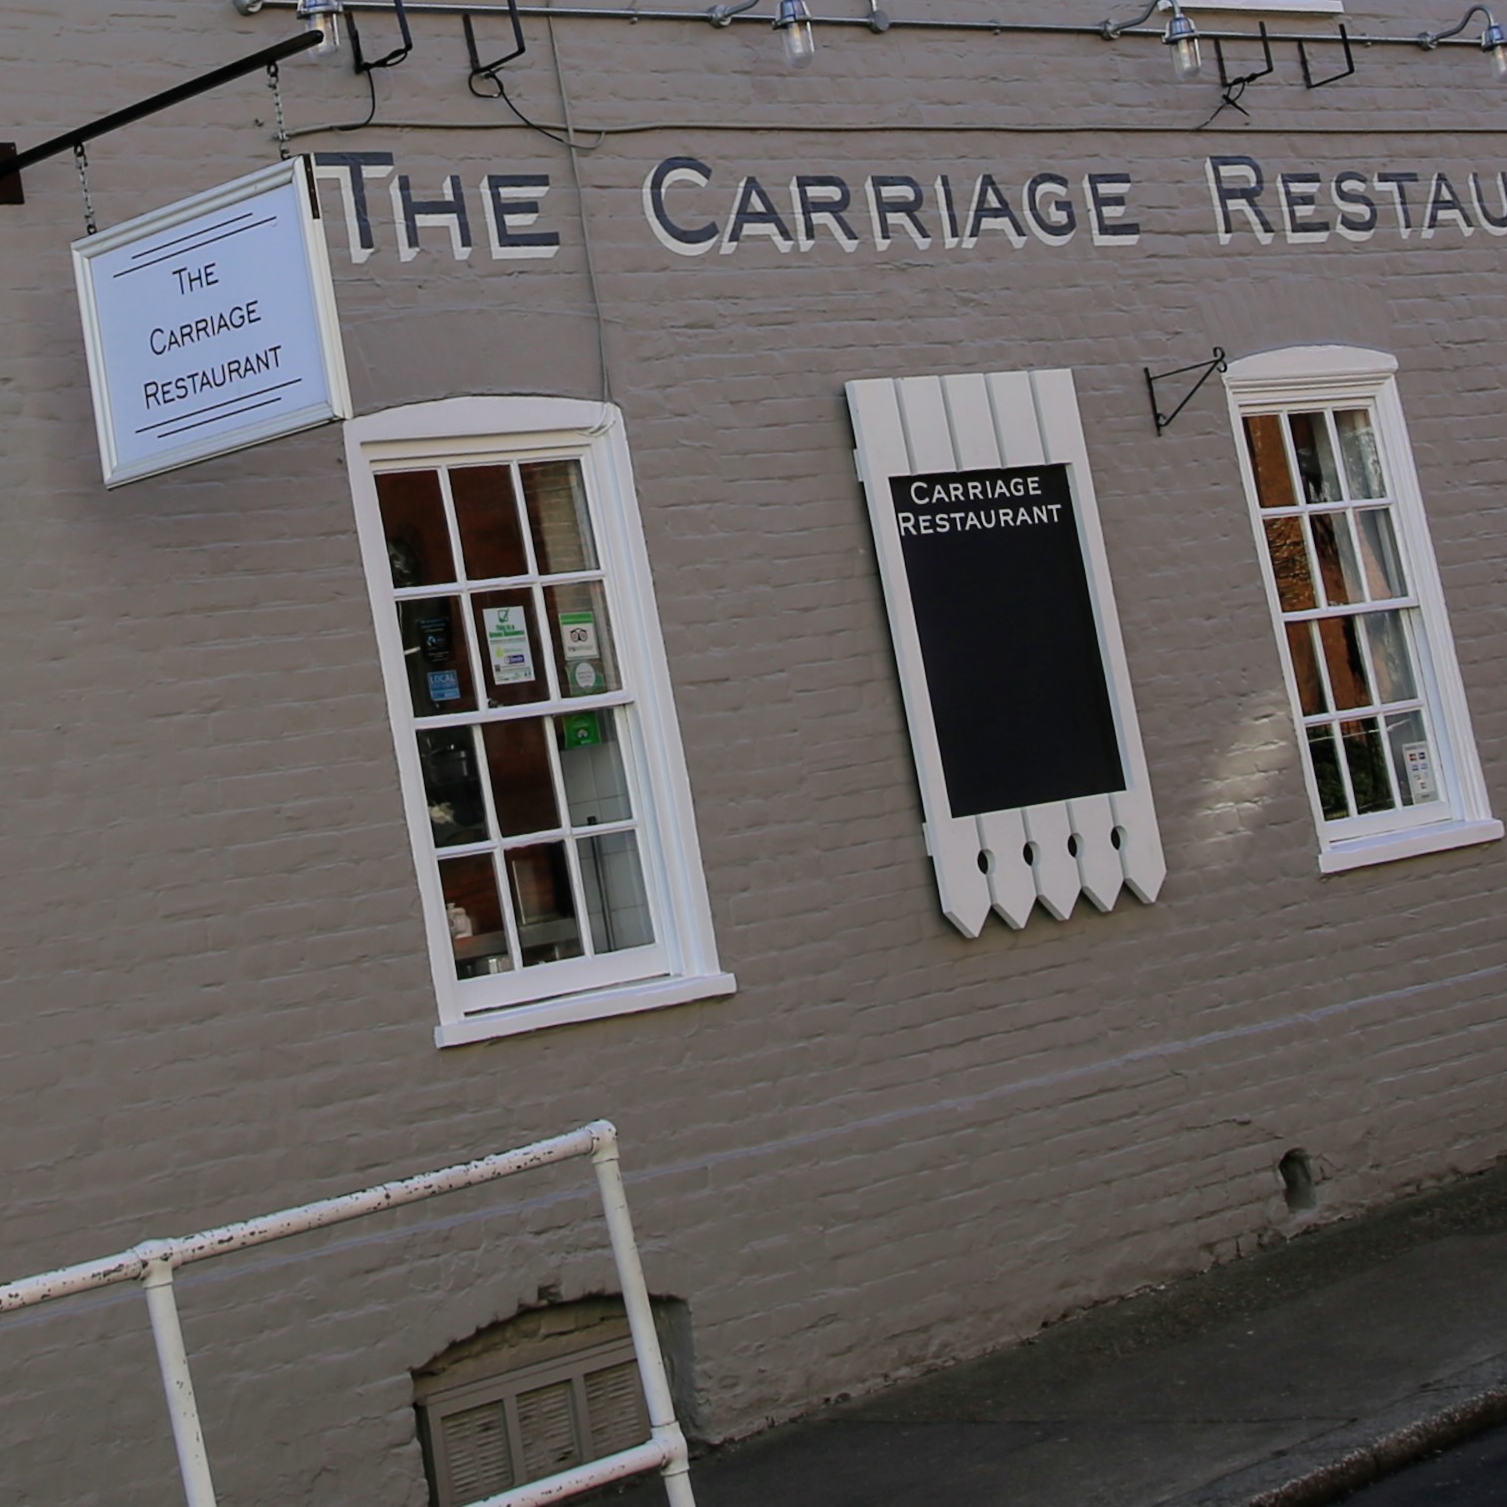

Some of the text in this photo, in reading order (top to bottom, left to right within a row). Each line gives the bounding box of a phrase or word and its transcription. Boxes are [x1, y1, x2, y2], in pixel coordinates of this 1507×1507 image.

[314, 151, 560, 264] THE
[641, 154, 1141, 256] CARRIAGE
[172, 263, 219, 294] THE
[150, 299, 261, 356] CARRIAGE
[144, 345, 282, 409] RESTAURANT
[910, 476, 1042, 505] CARRIAGE
[898, 504, 1062, 536] RESTAURANT
[429, 673, 456, 685] LOCAL
